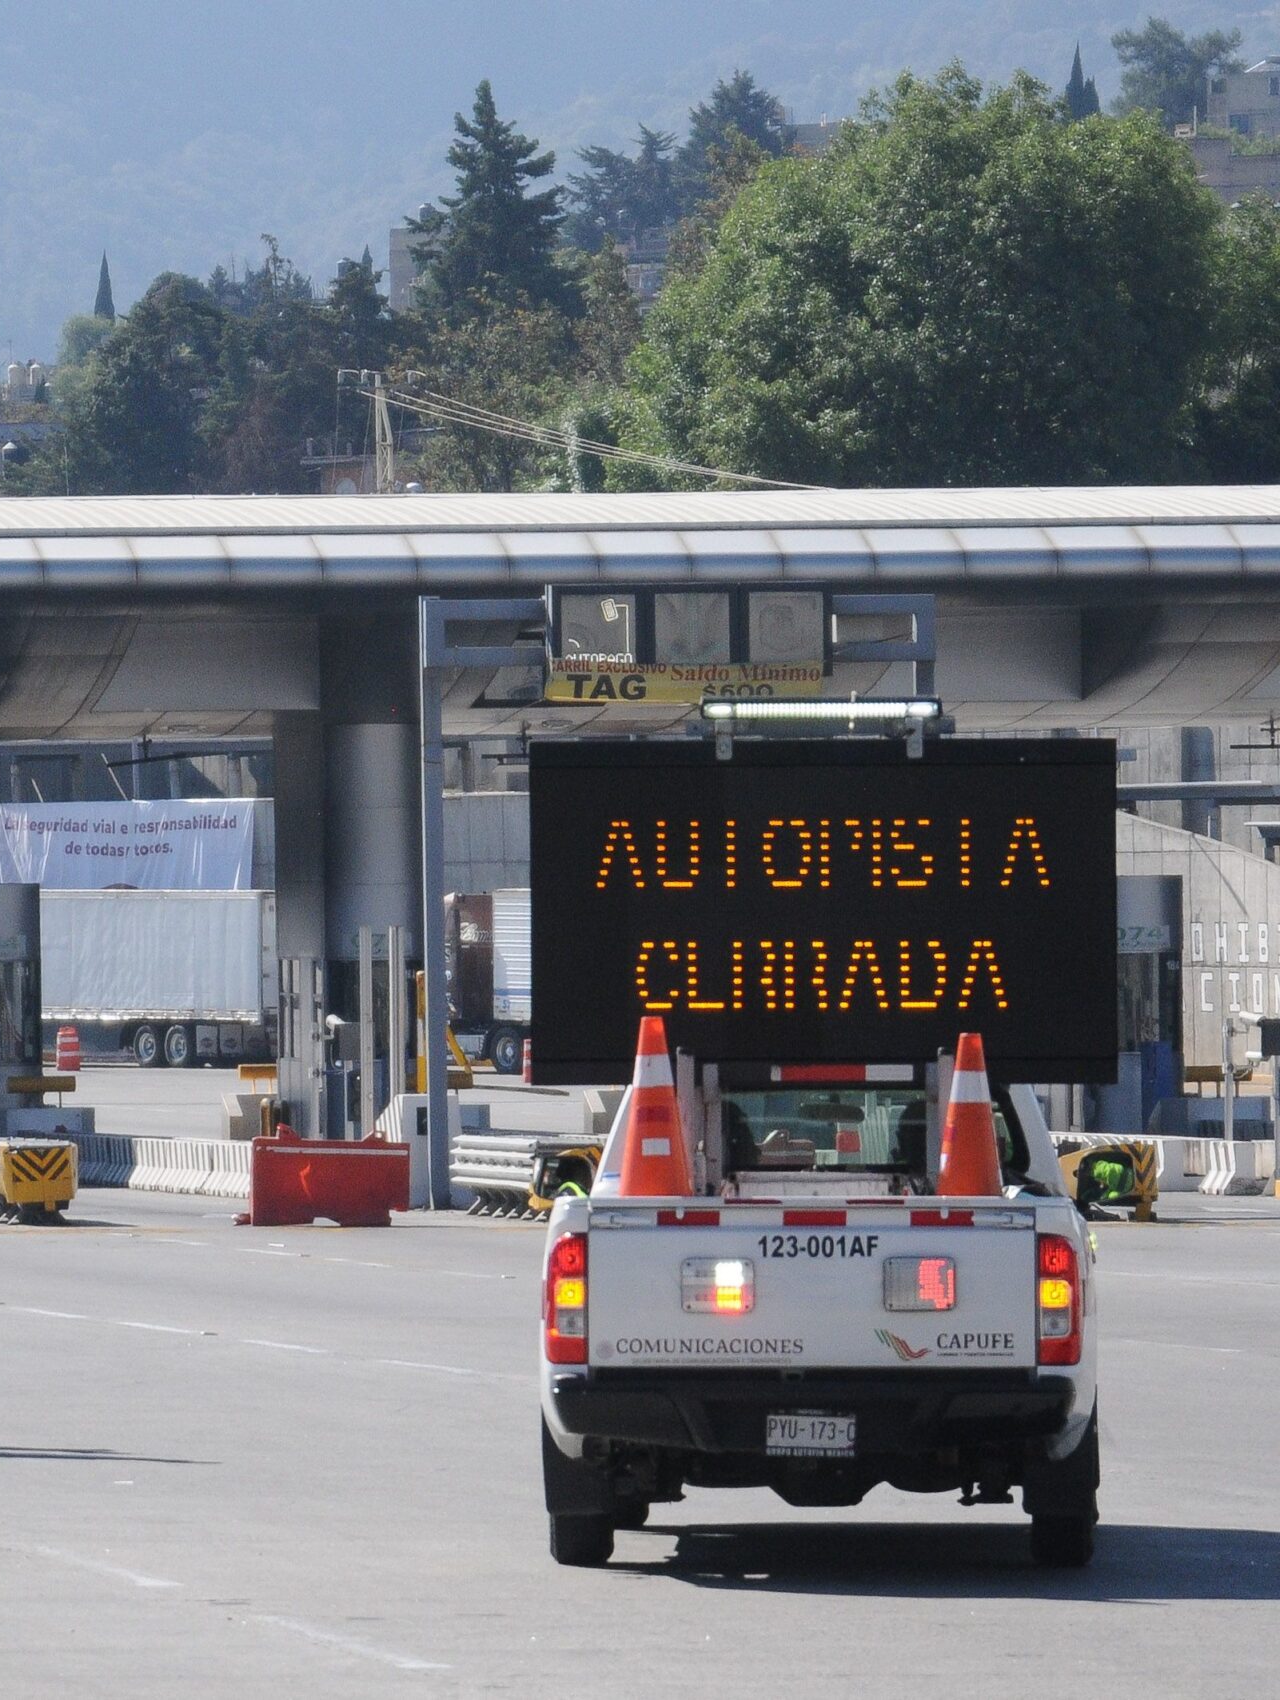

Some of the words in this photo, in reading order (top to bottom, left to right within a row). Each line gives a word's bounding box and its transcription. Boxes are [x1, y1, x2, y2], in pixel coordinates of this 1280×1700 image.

[597, 662, 667, 674] EXCLUSIVO
[670, 663, 730, 682] Saldo
[567, 674, 647, 700] TAG
[23, 818, 88, 834] eguridad
[93, 819, 115, 834] vial
[120, 824, 128, 834] e
[65, 841, 82, 855] de
[758, 1235, 878, 1258] 123-001AF
[616, 1338, 803, 1354] COMUNICACIONES
[937, 1333, 1014, 1349] CAPUFE
